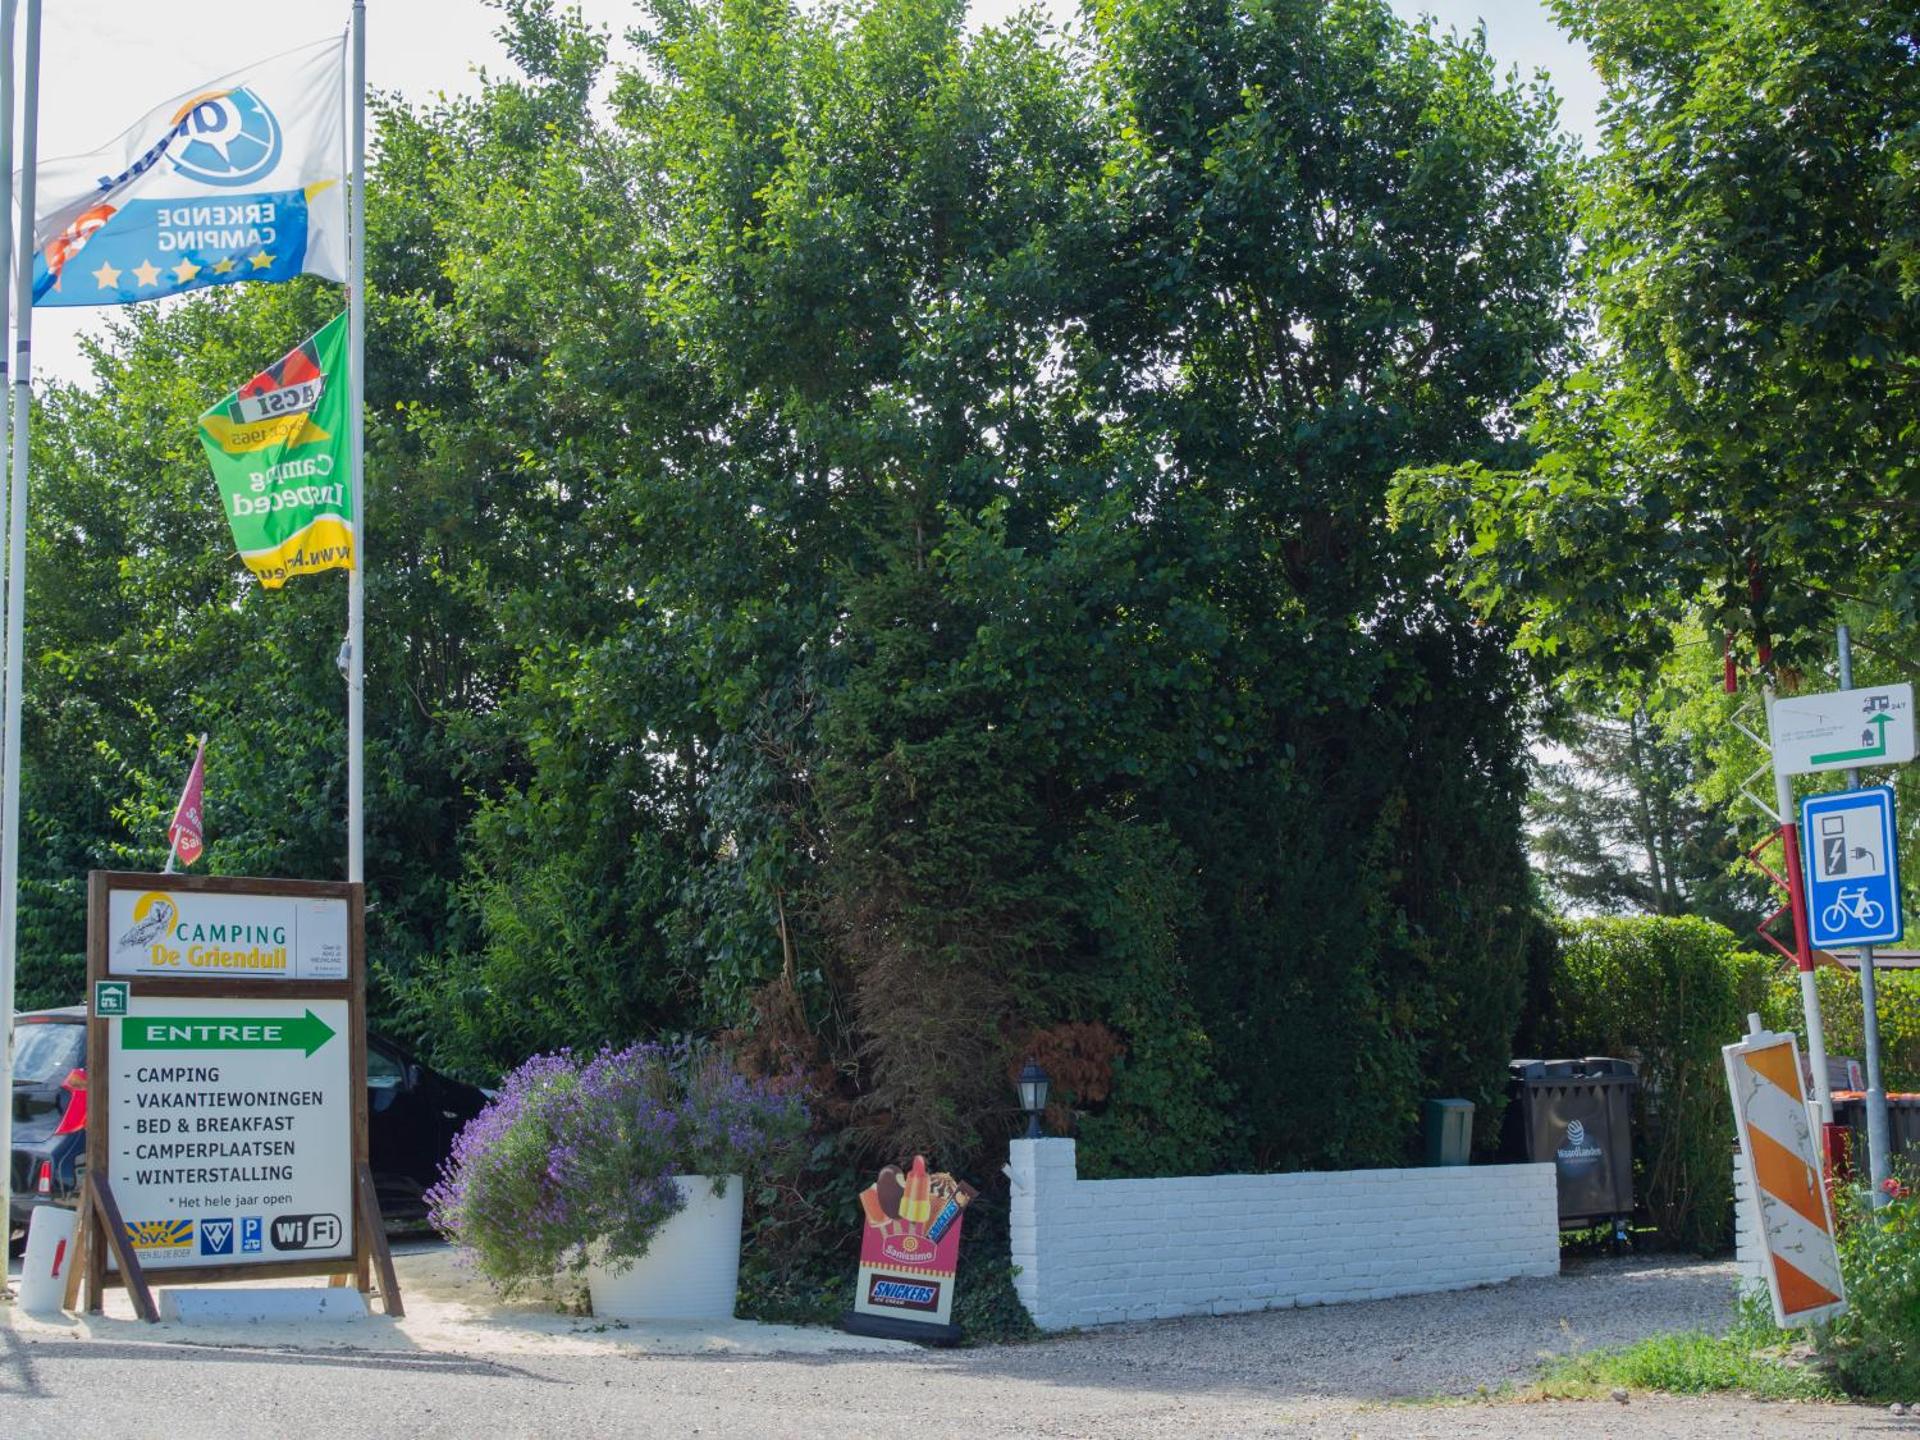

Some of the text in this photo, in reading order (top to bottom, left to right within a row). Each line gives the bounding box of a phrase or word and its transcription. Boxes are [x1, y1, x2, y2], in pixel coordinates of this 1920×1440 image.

[176, 922, 286, 945] CAMPING
[151, 944, 180, 966] De
[146, 1025, 283, 1042] ENTREE
[137, 1067, 220, 1082] CAMPING
[137, 1091, 323, 1108] VAKANTIEWONINGEN
[137, 1118, 171, 1134] BED
[177, 1118, 190, 1133] &
[196, 1116, 295, 1132] BREAKFAST
[136, 1141, 295, 1160] CAMPERPLAATSEN
[136, 1166, 293, 1185] WINTERSTALLING
[178, 1194, 293, 1208] Het hele jaar open
[246, 1219, 258, 1237] P
[874, 1282, 935, 1302] SNICKERS
